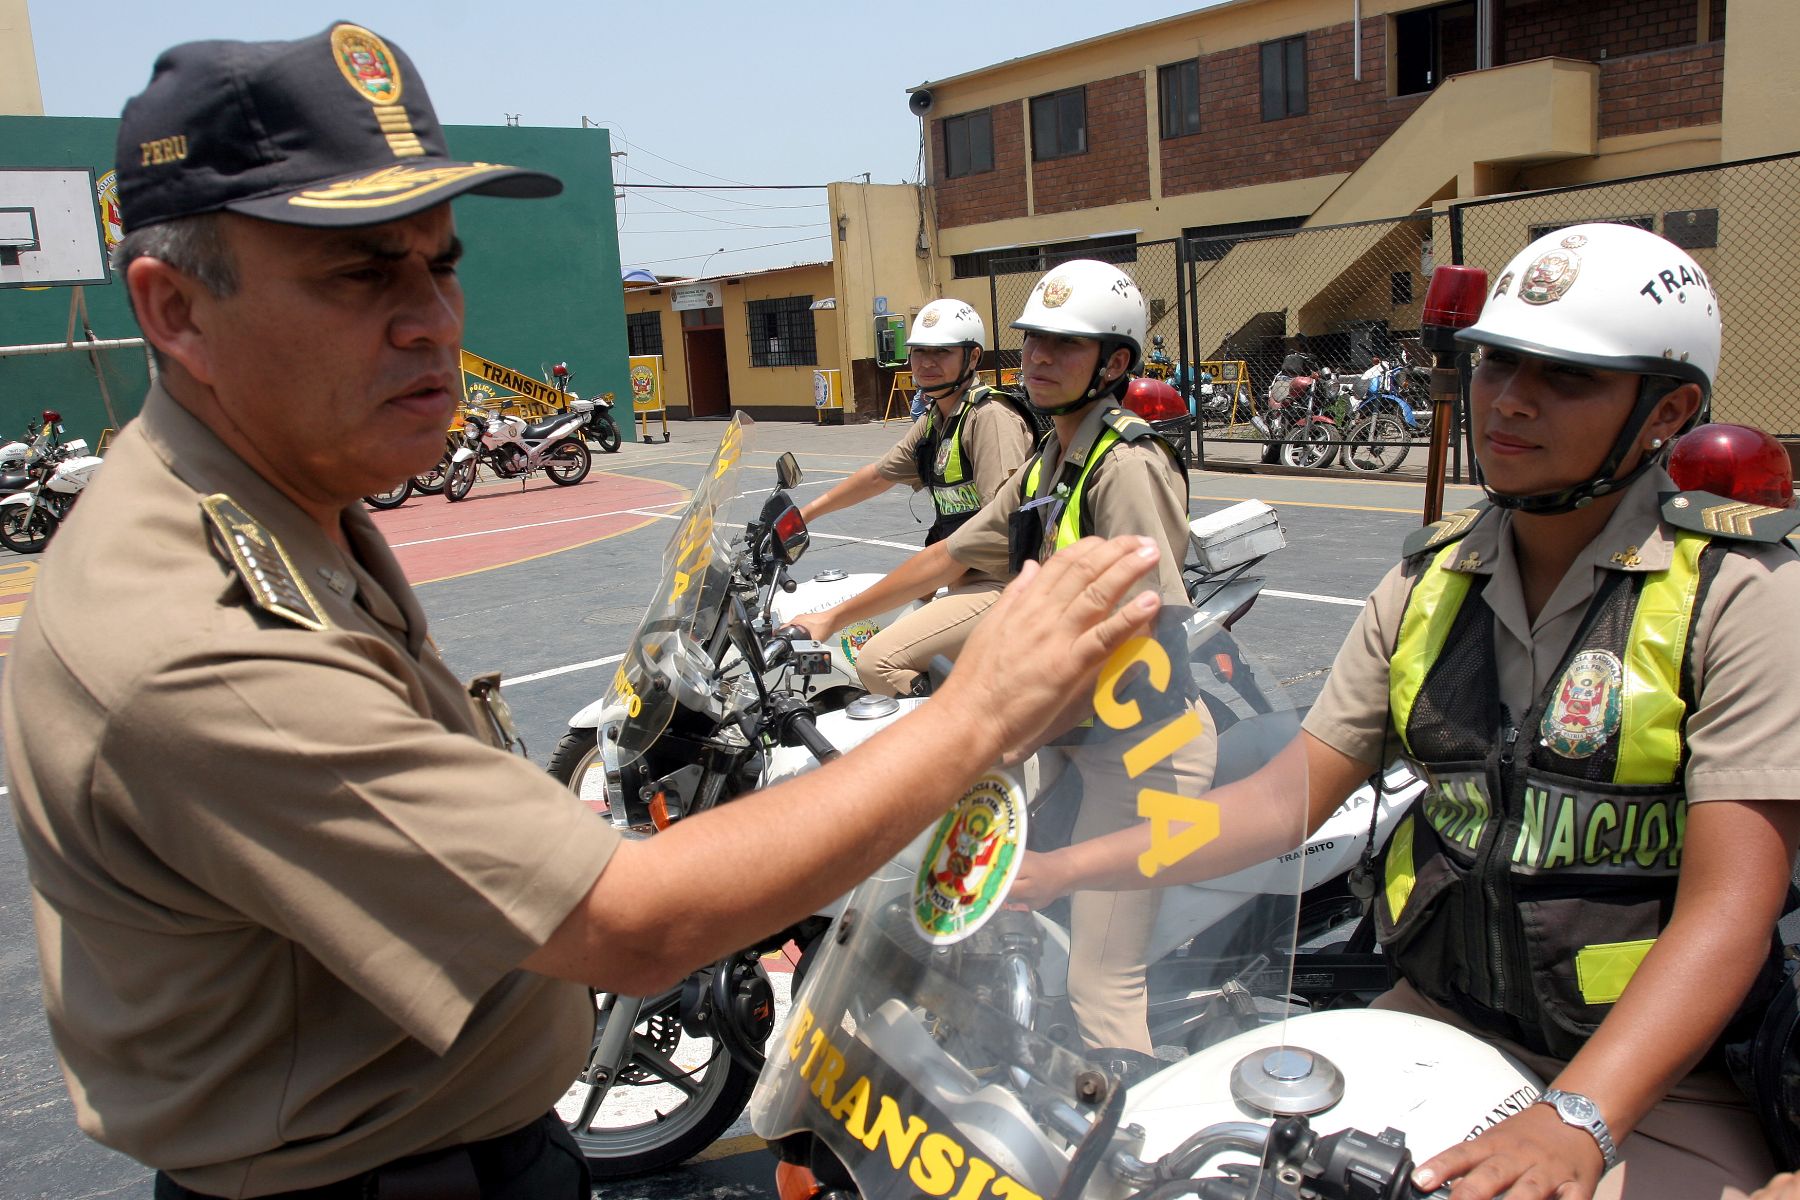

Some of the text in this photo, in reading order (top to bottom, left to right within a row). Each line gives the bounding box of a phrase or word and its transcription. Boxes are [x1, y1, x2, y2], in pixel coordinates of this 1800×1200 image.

[140, 135, 188, 167] PERU
[469, 383, 497, 398] POLICIA
[482, 362, 558, 405] TRANSITO
[1277, 841, 1335, 864] TRANSITO
